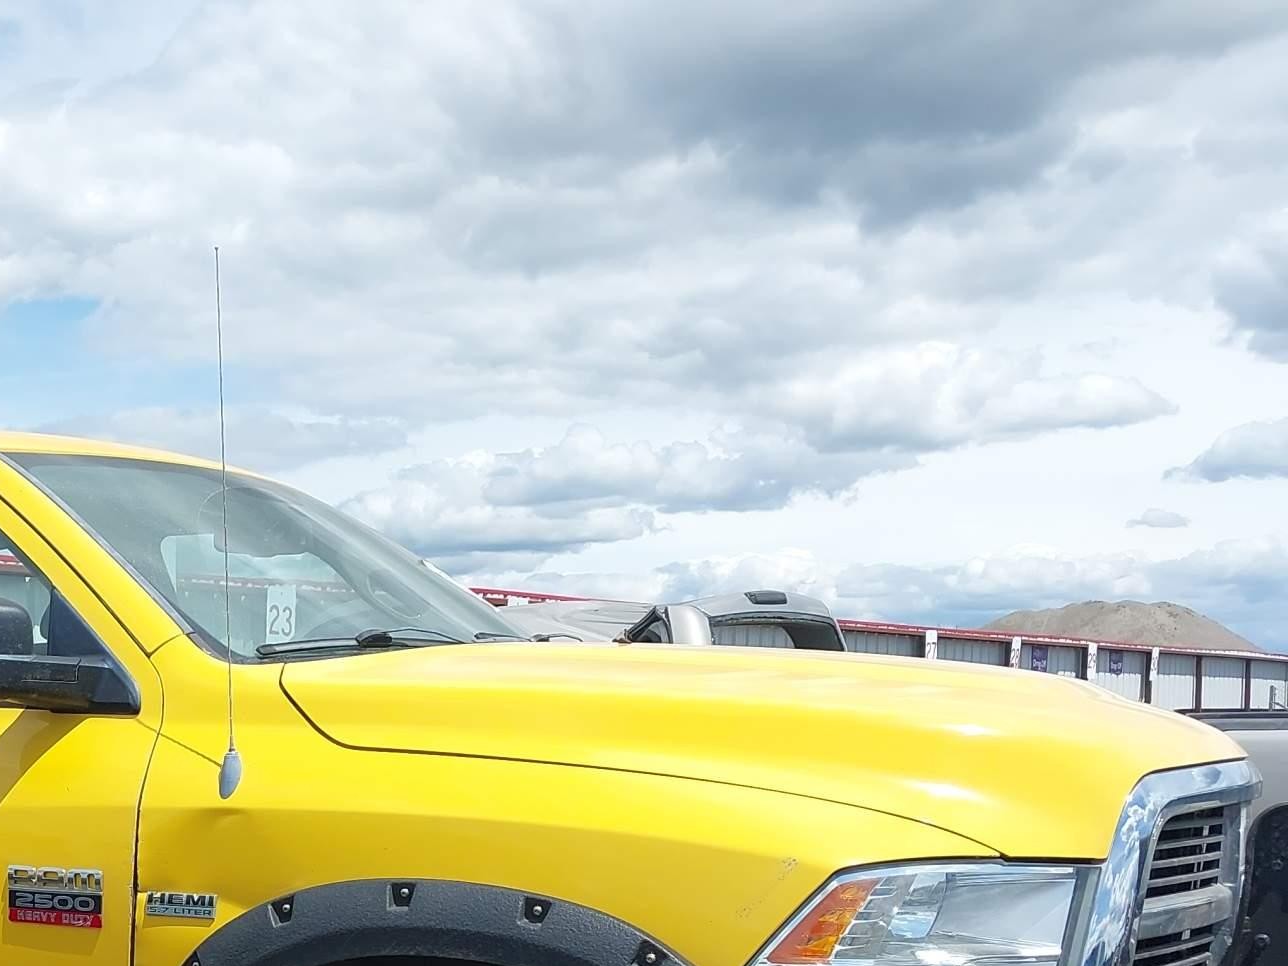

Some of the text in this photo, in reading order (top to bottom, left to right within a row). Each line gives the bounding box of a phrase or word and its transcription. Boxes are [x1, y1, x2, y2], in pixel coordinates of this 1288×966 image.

[268, 604, 293, 637] 23
[926, 641, 937, 659] 27
[1087, 652, 1097, 670] 29
[15, 892, 95, 912] 2500
[147, 892, 215, 907] HEMI
[16, 909, 94, 927] HEAVY DUTY
[173, 907, 212, 916] LITER
